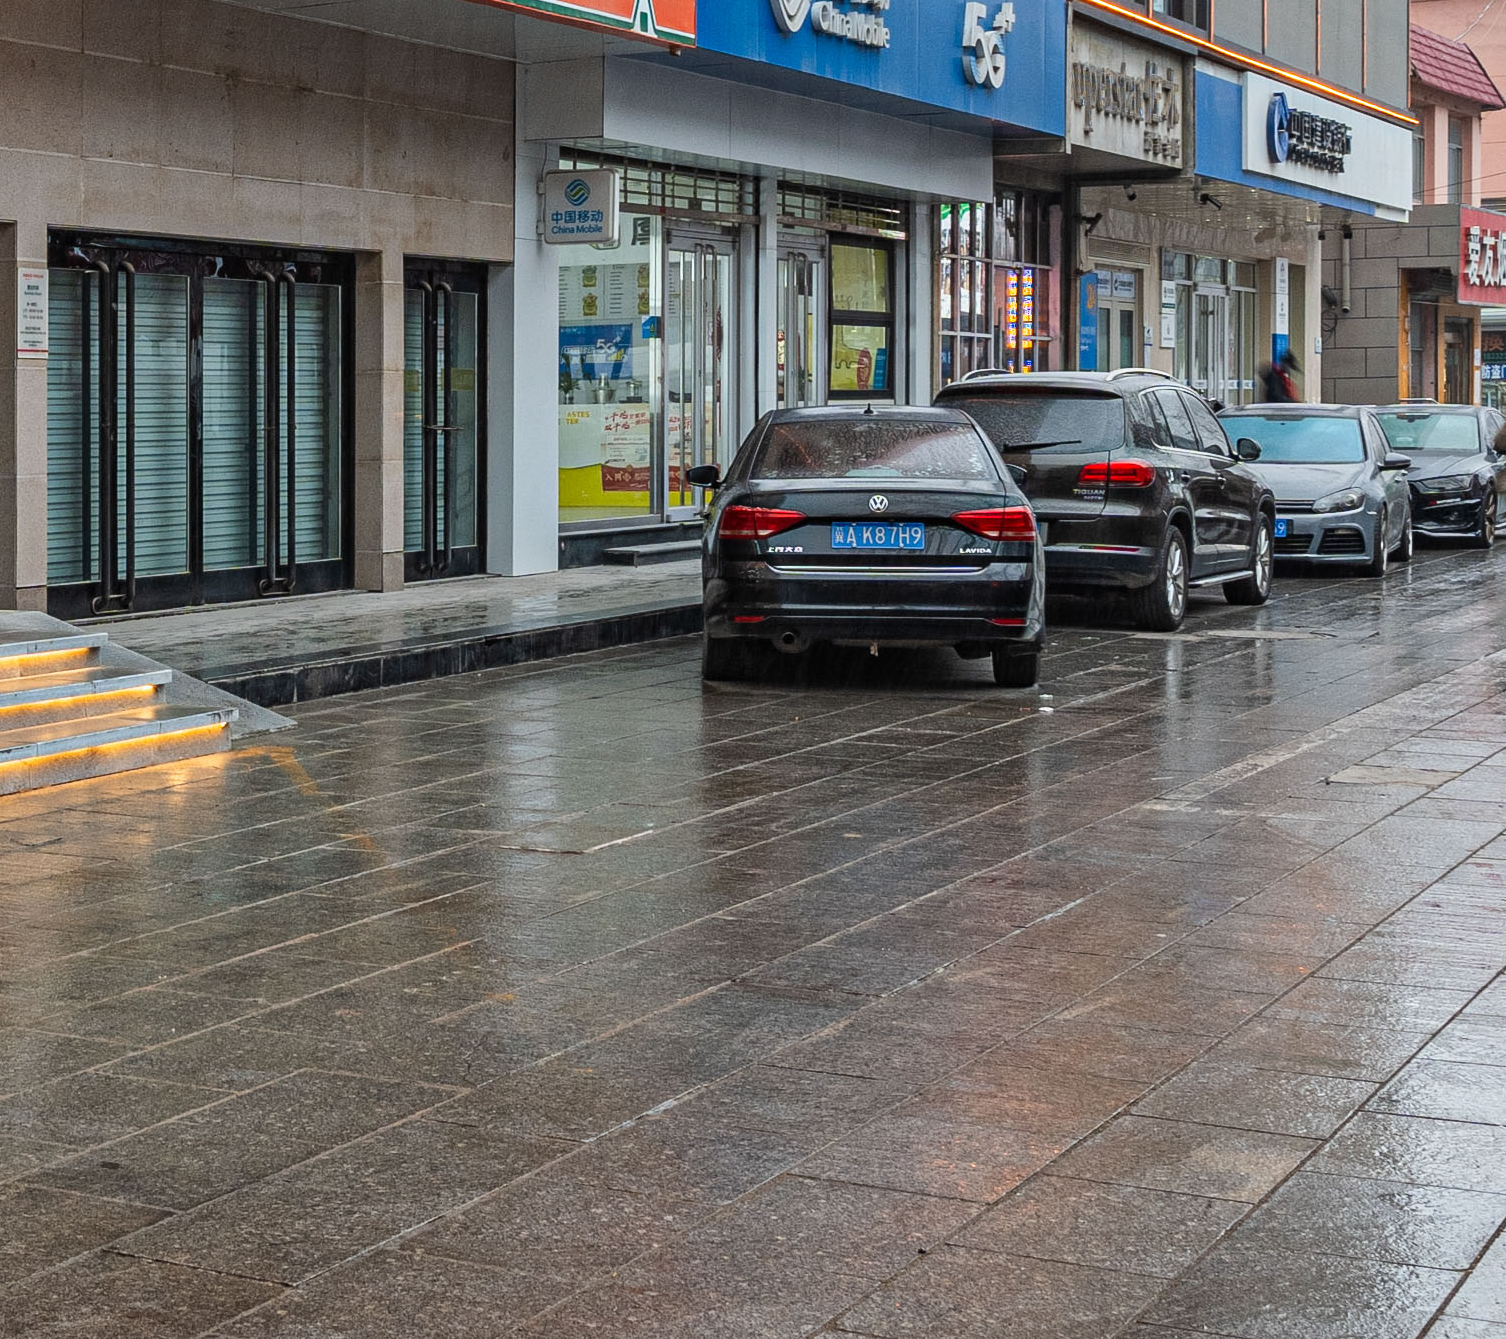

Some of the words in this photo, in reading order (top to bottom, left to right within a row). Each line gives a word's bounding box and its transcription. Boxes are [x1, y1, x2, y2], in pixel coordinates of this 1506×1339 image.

[551, 209, 604, 225] 中国移动
[551, 225, 575, 235] China
[576, 224, 603, 234] Mobile
[959, 547, 993, 555] LAVIDA
